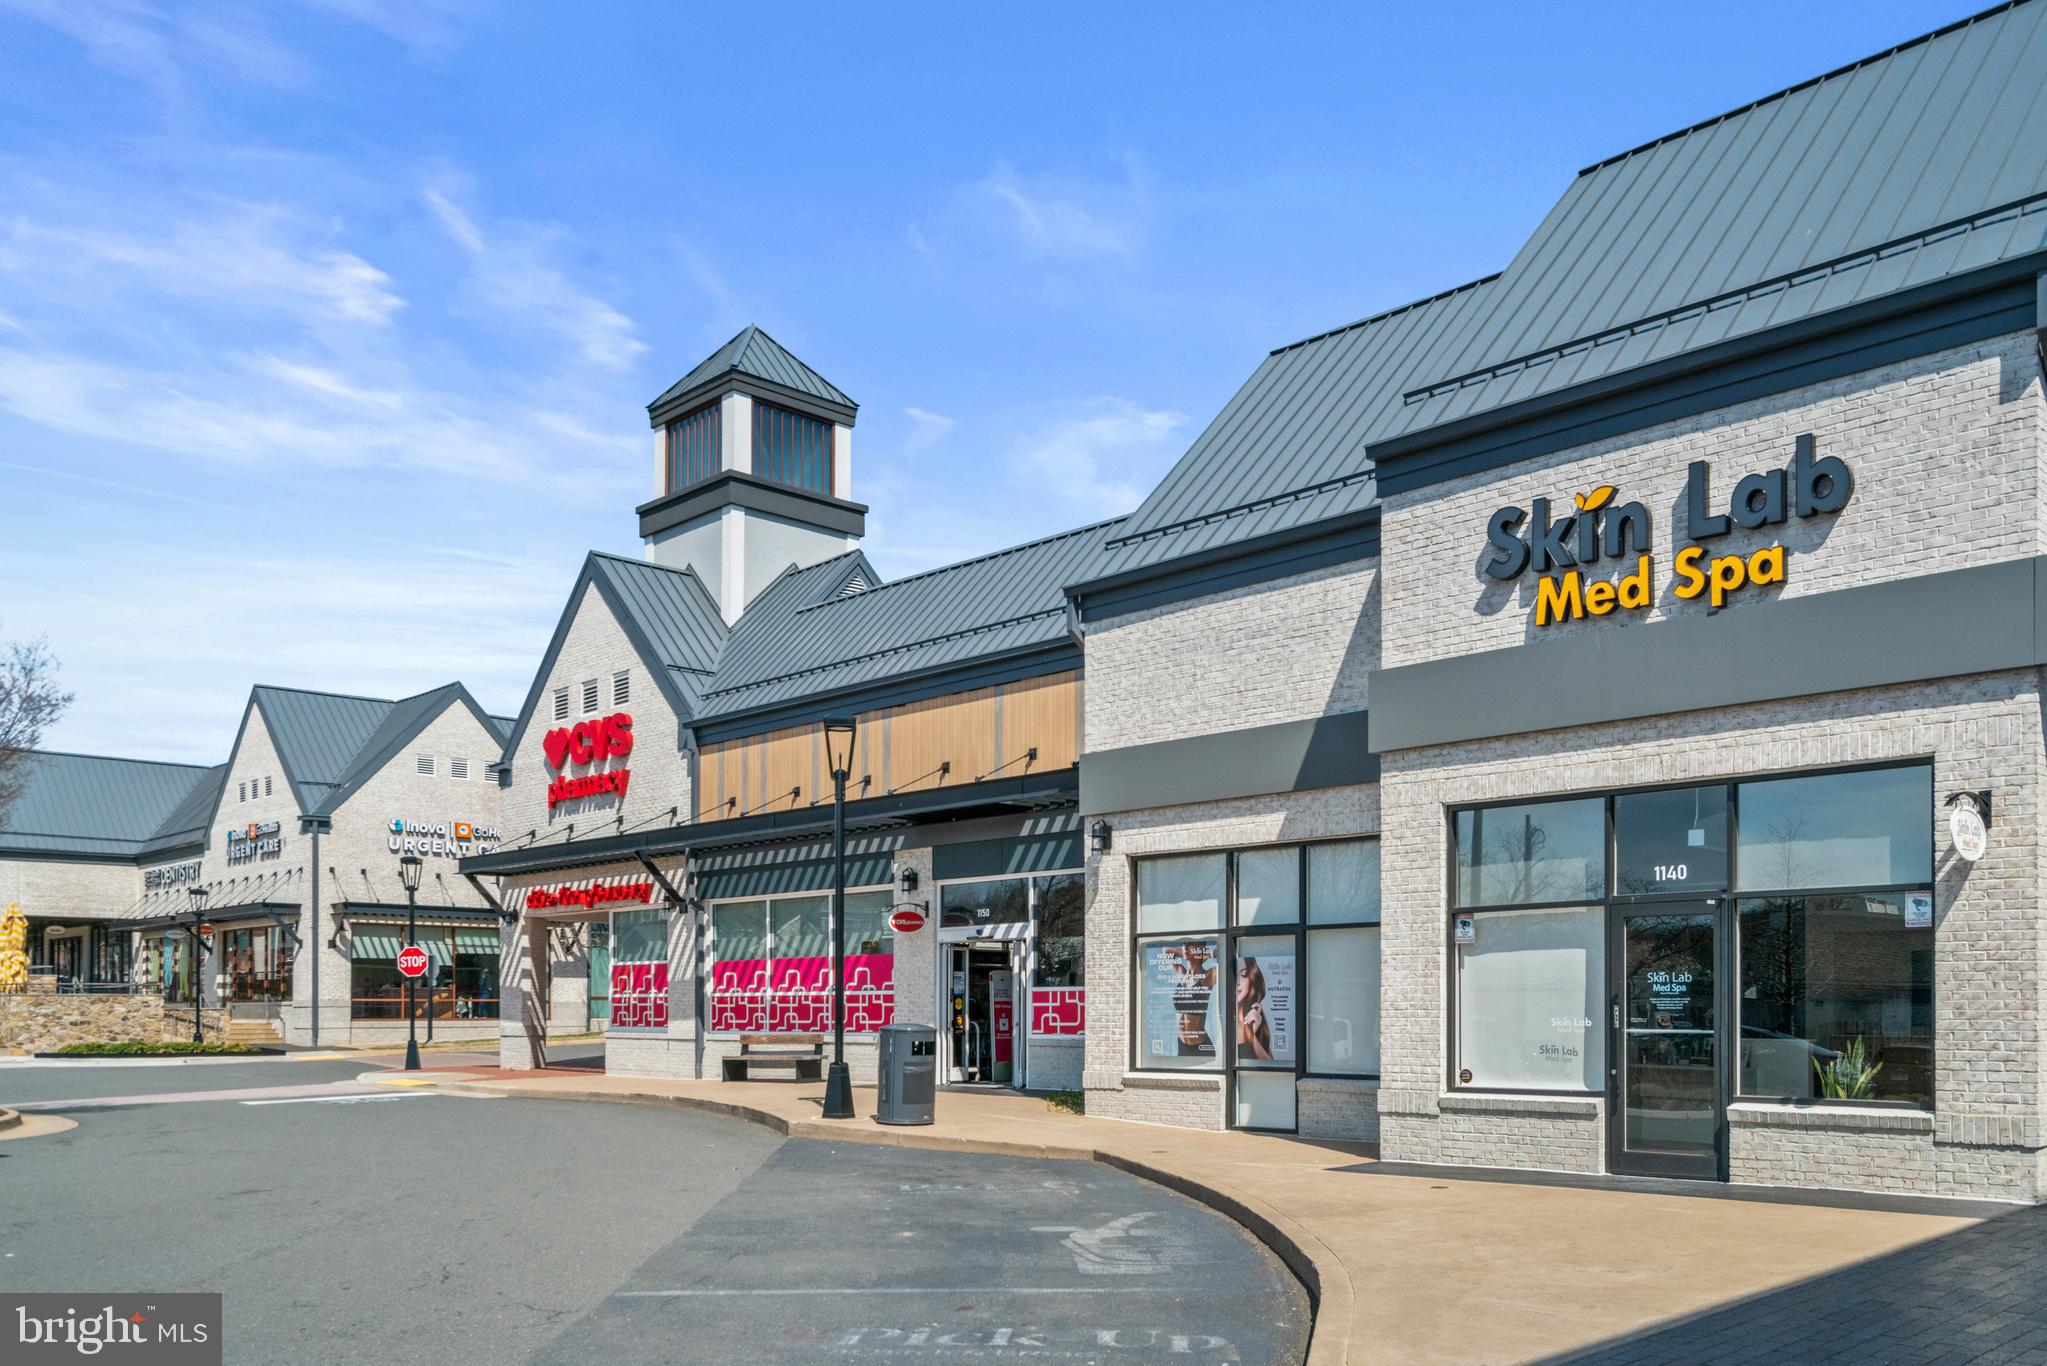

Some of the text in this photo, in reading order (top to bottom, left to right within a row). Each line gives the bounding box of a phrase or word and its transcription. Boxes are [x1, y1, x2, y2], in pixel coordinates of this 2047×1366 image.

[1485, 433, 1854, 580] Skin Lab
[1536, 545, 1787, 626] Med Spa
[569, 712, 634, 766] CVS
[547, 768, 631, 809] pharmacy
[406, 820, 446, 834] Inova
[258, 838, 281, 854] CARE
[388, 838, 469, 855] URGENT
[160, 861, 201, 883] DENTISTRY
[1654, 865, 1687, 881] 1140
[977, 909, 990, 917] 1150
[400, 956, 426, 968] STOP
[1647, 971, 1693, 983] Skin Lab
[1652, 983, 1687, 993] Med Spa
[1551, 1017, 1592, 1027] Skin Lab
